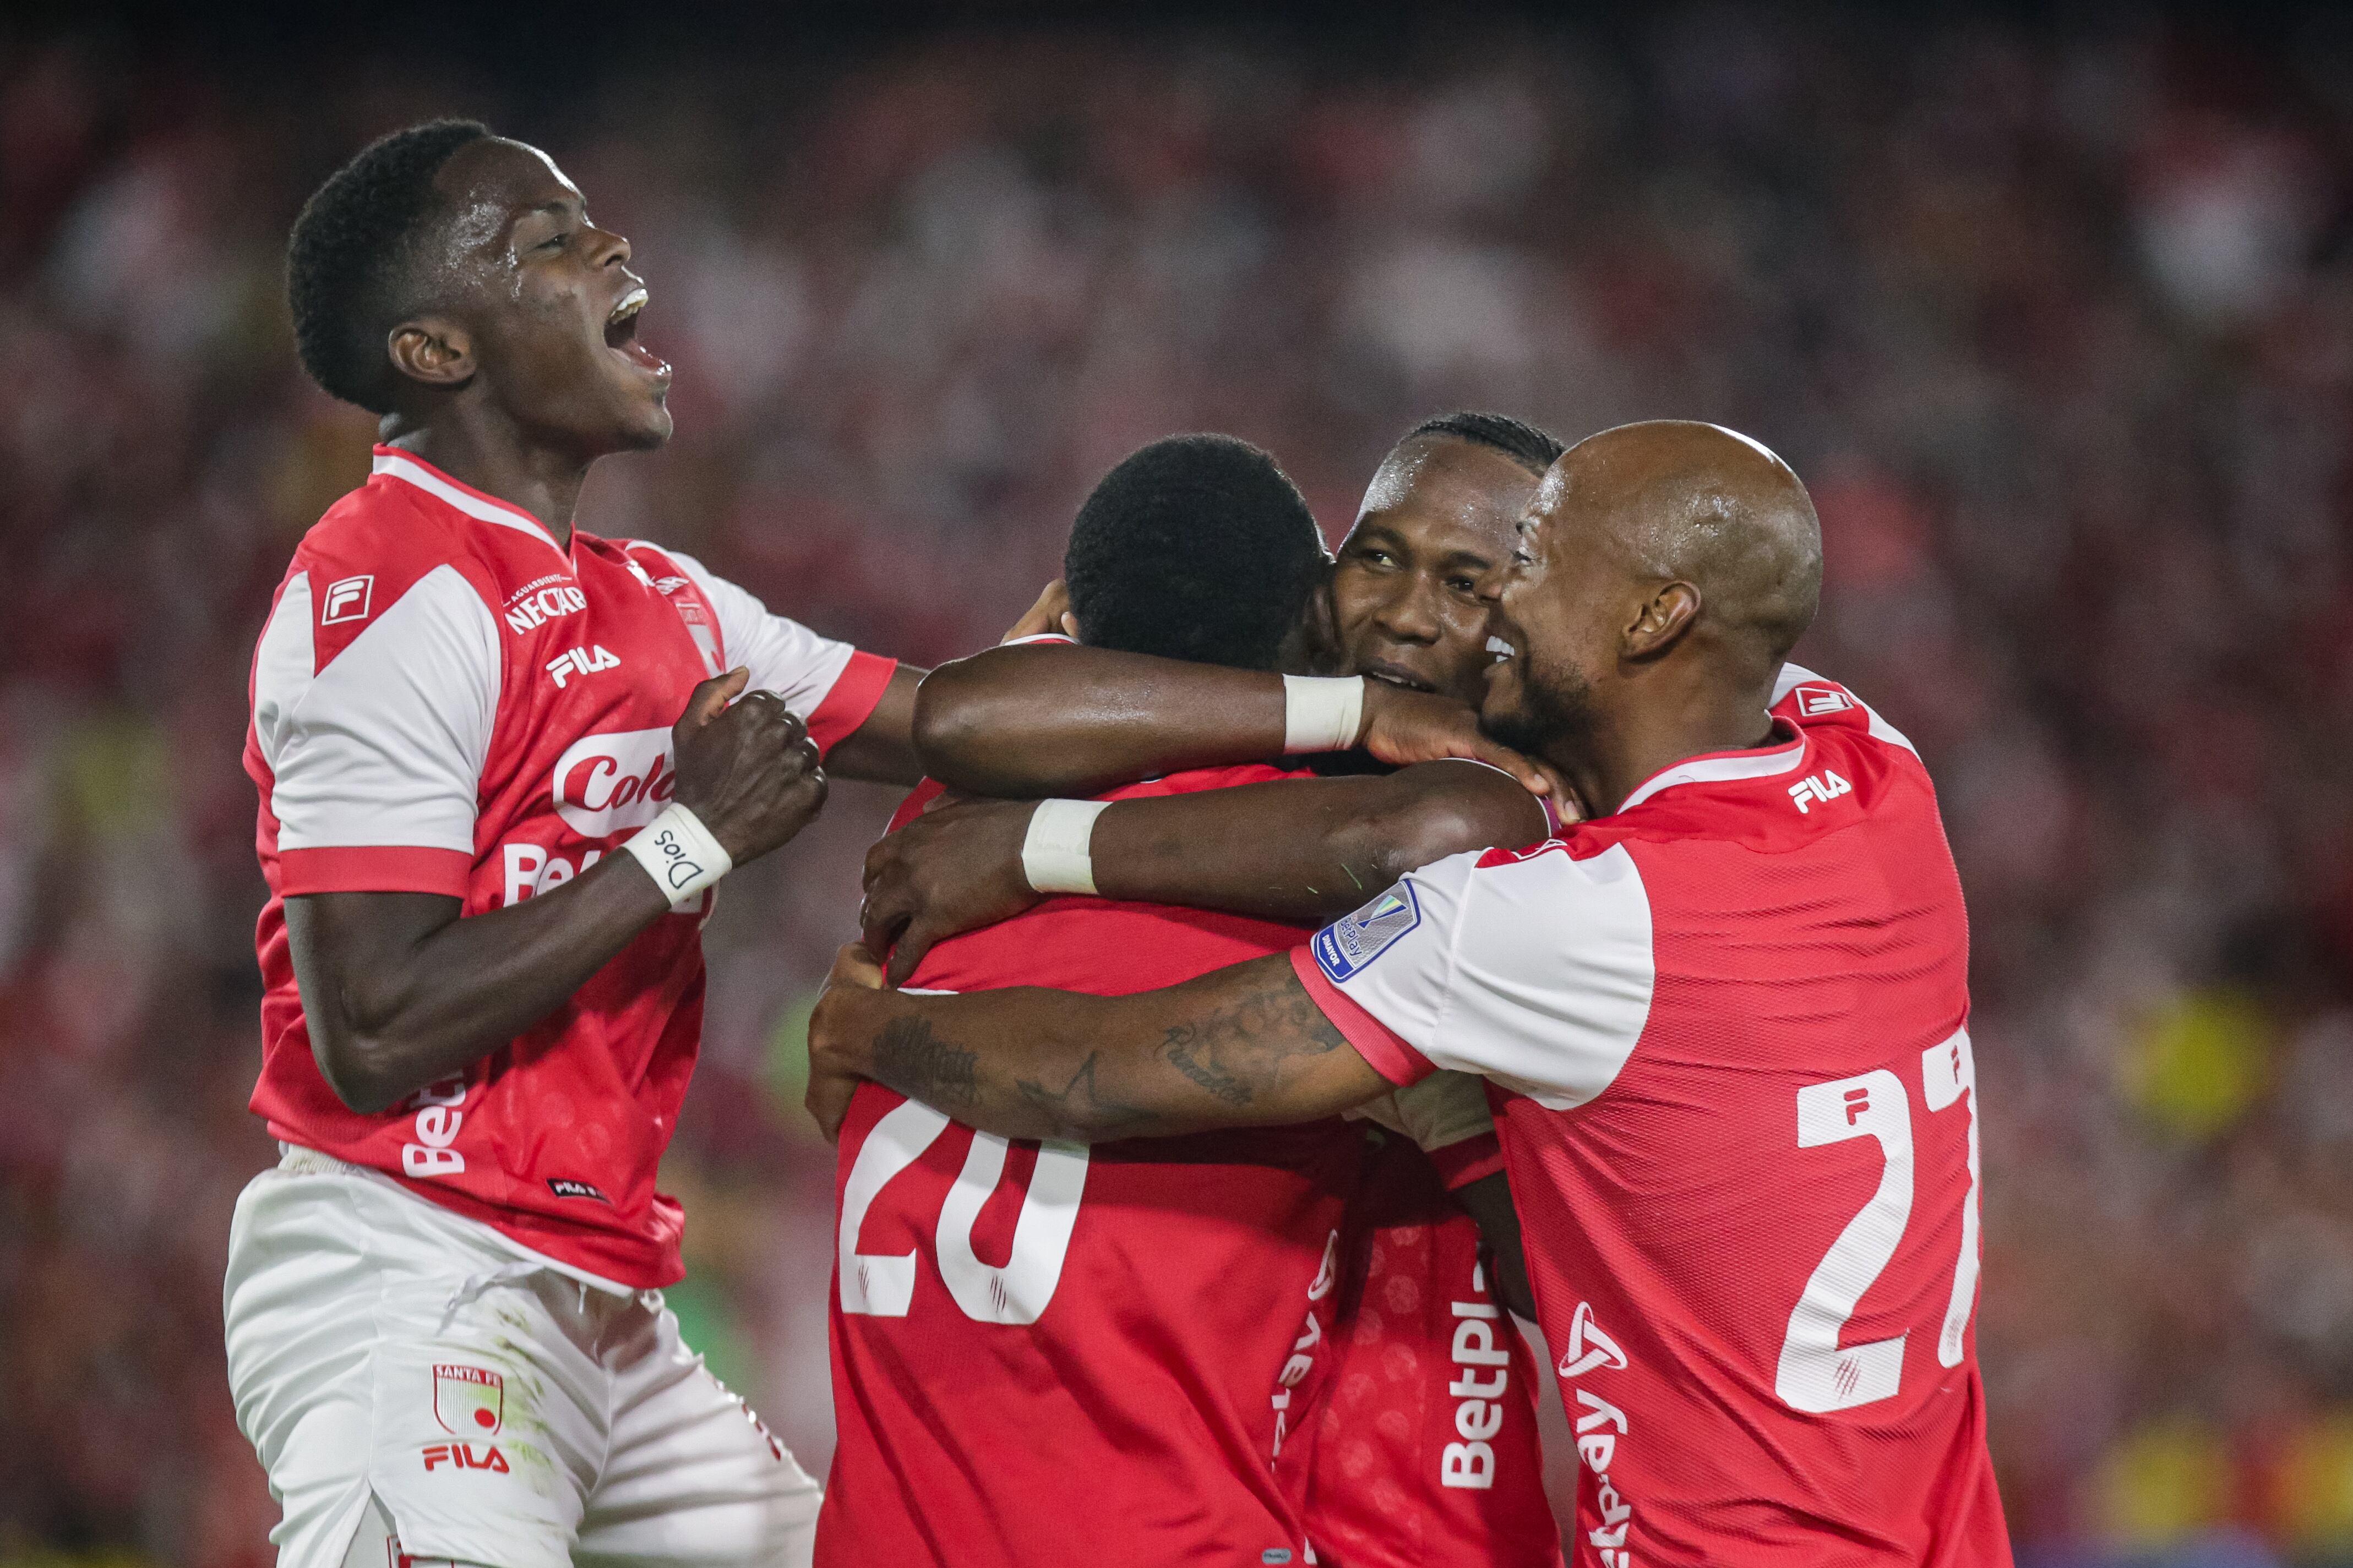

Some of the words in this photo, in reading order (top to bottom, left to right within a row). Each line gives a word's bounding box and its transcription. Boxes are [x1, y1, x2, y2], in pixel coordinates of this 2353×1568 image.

[504, 586, 587, 636] NECTAR
[545, 644, 621, 689] FILA
[1787, 769, 1852, 814] FILA
[655, 830, 704, 890] Dios
[1322, 934, 1341, 967] DIMAYOR
[838, 1097, 1090, 1326] 20
[1775, 1025, 1980, 1413] 27
[422, 1443, 510, 1474] FILA
